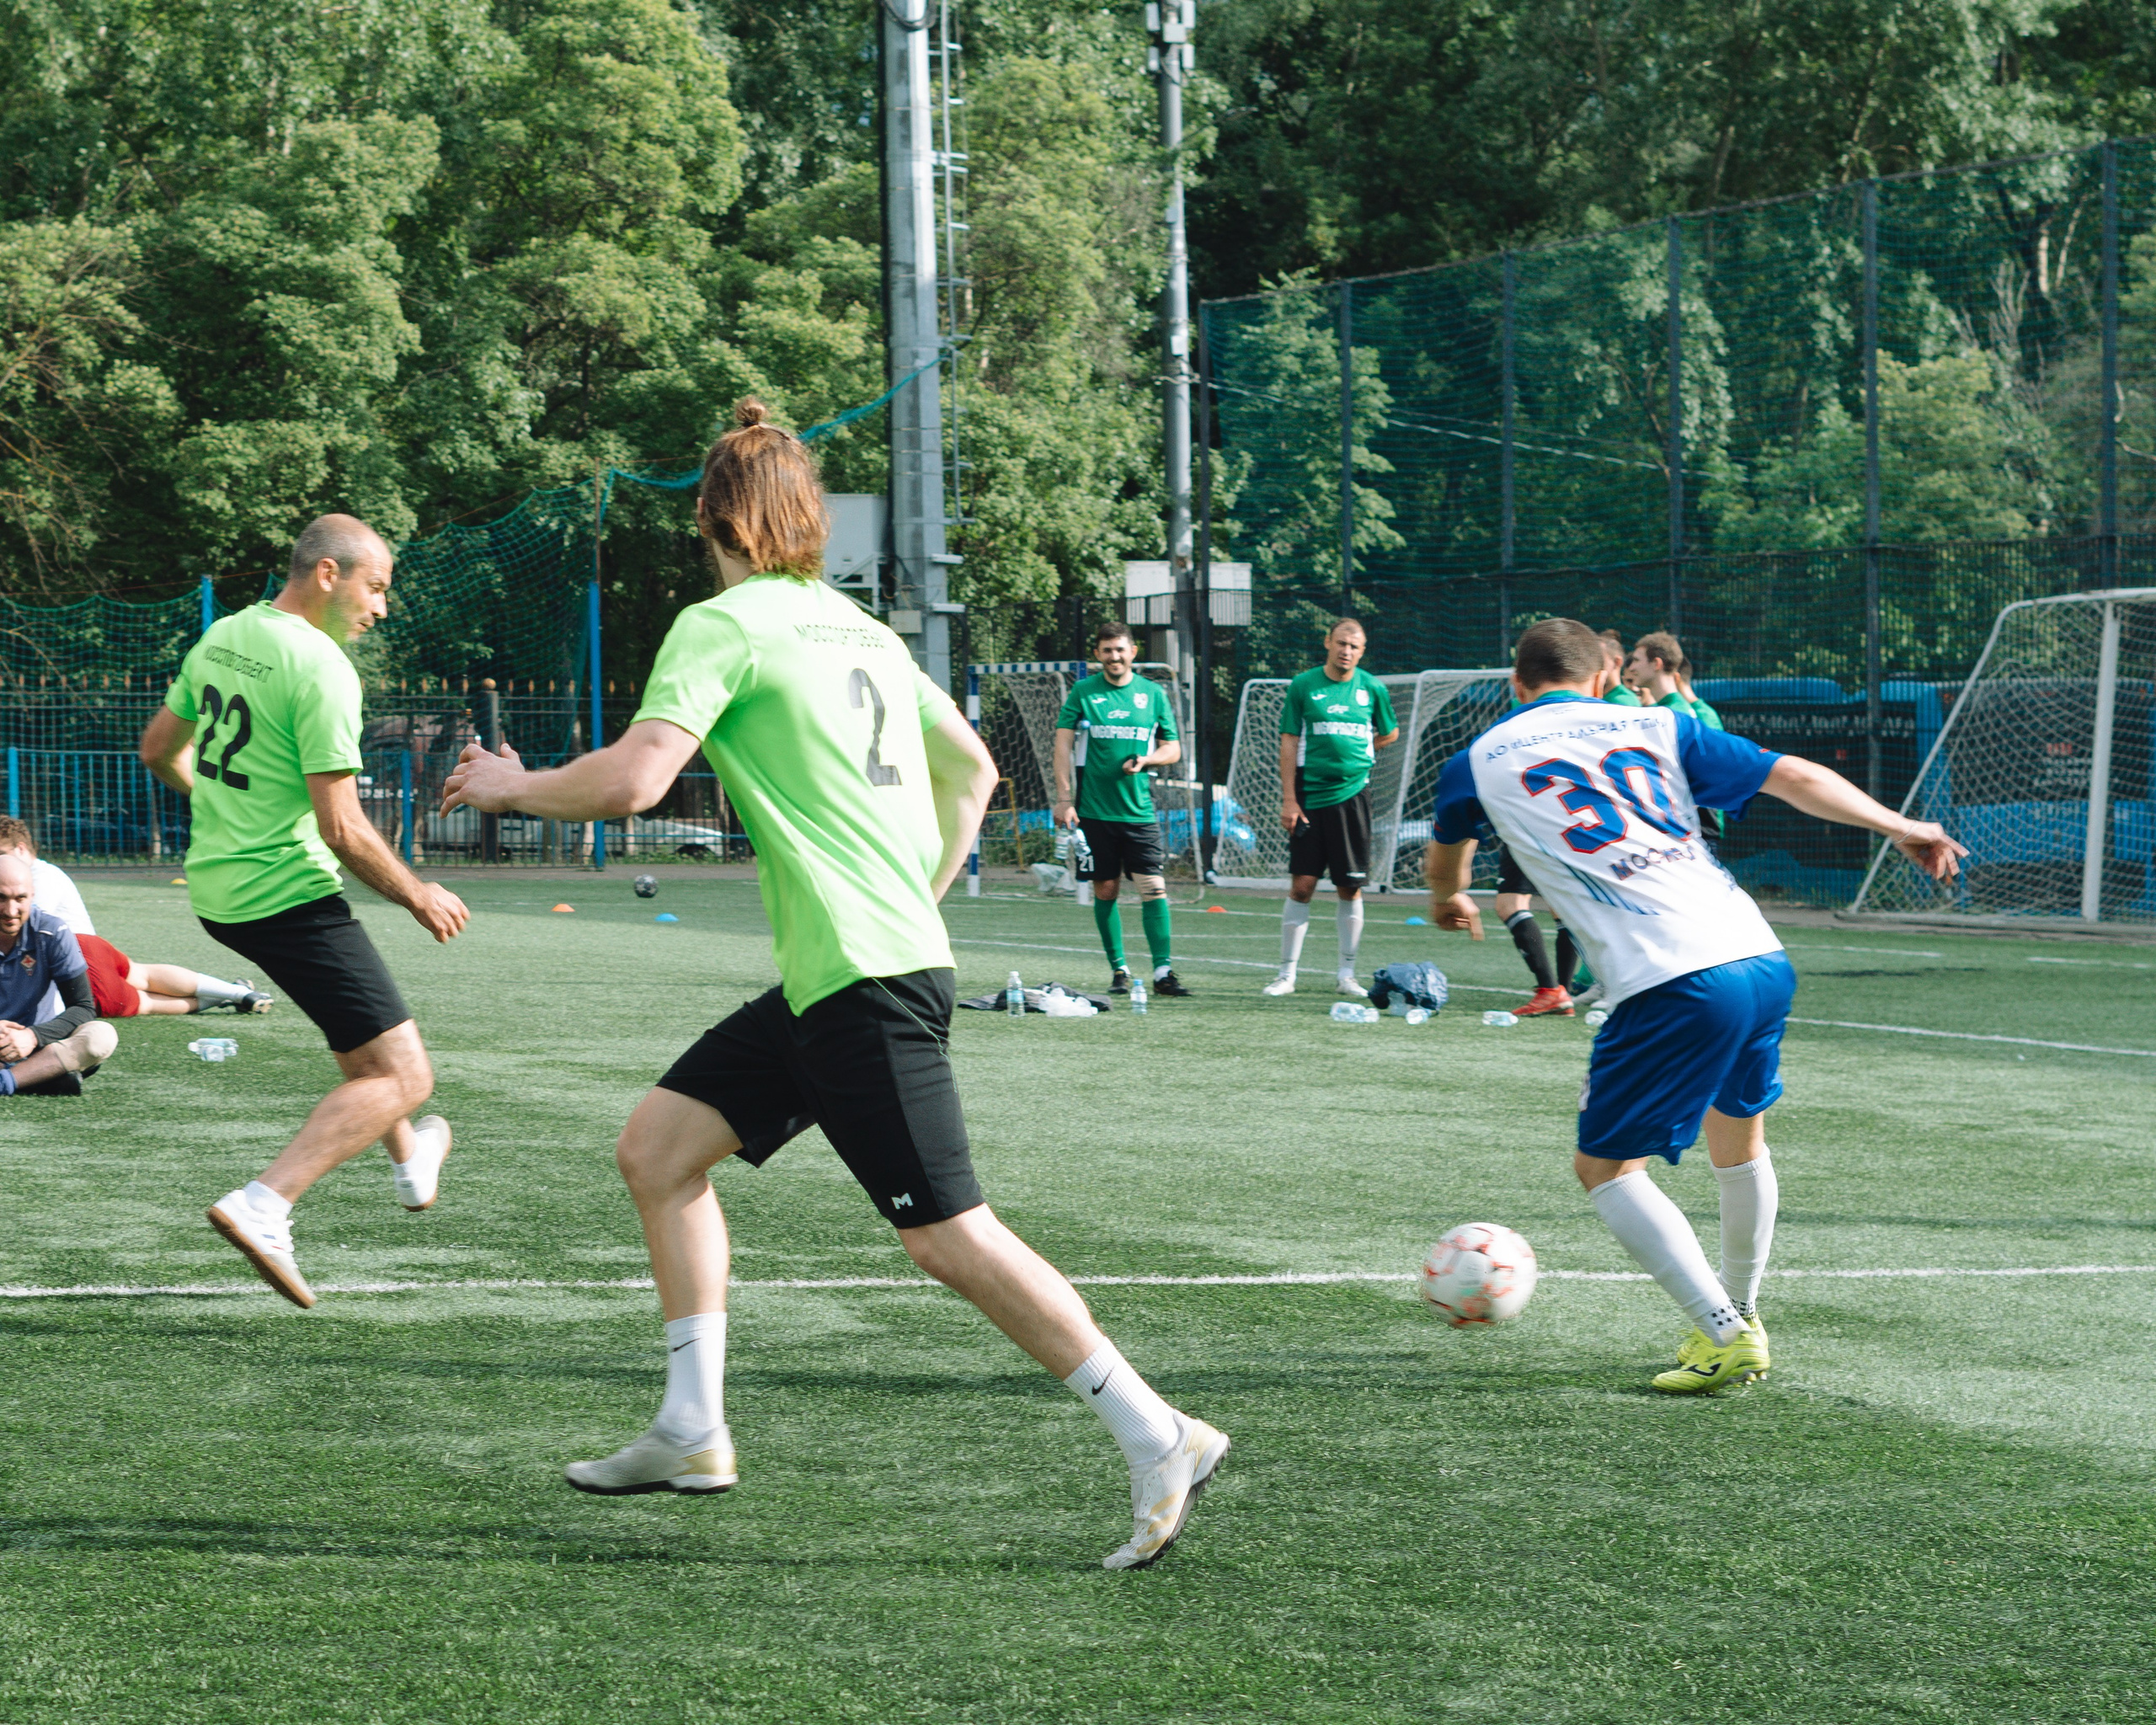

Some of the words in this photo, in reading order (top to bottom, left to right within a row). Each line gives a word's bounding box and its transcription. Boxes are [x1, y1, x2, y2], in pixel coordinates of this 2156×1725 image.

[197, 684, 251, 791] 22
[849, 668, 902, 786] 2
[1486, 745, 1508, 763] АО
[1521, 746, 1691, 854] 30
[1078, 855, 1095, 872] 21
